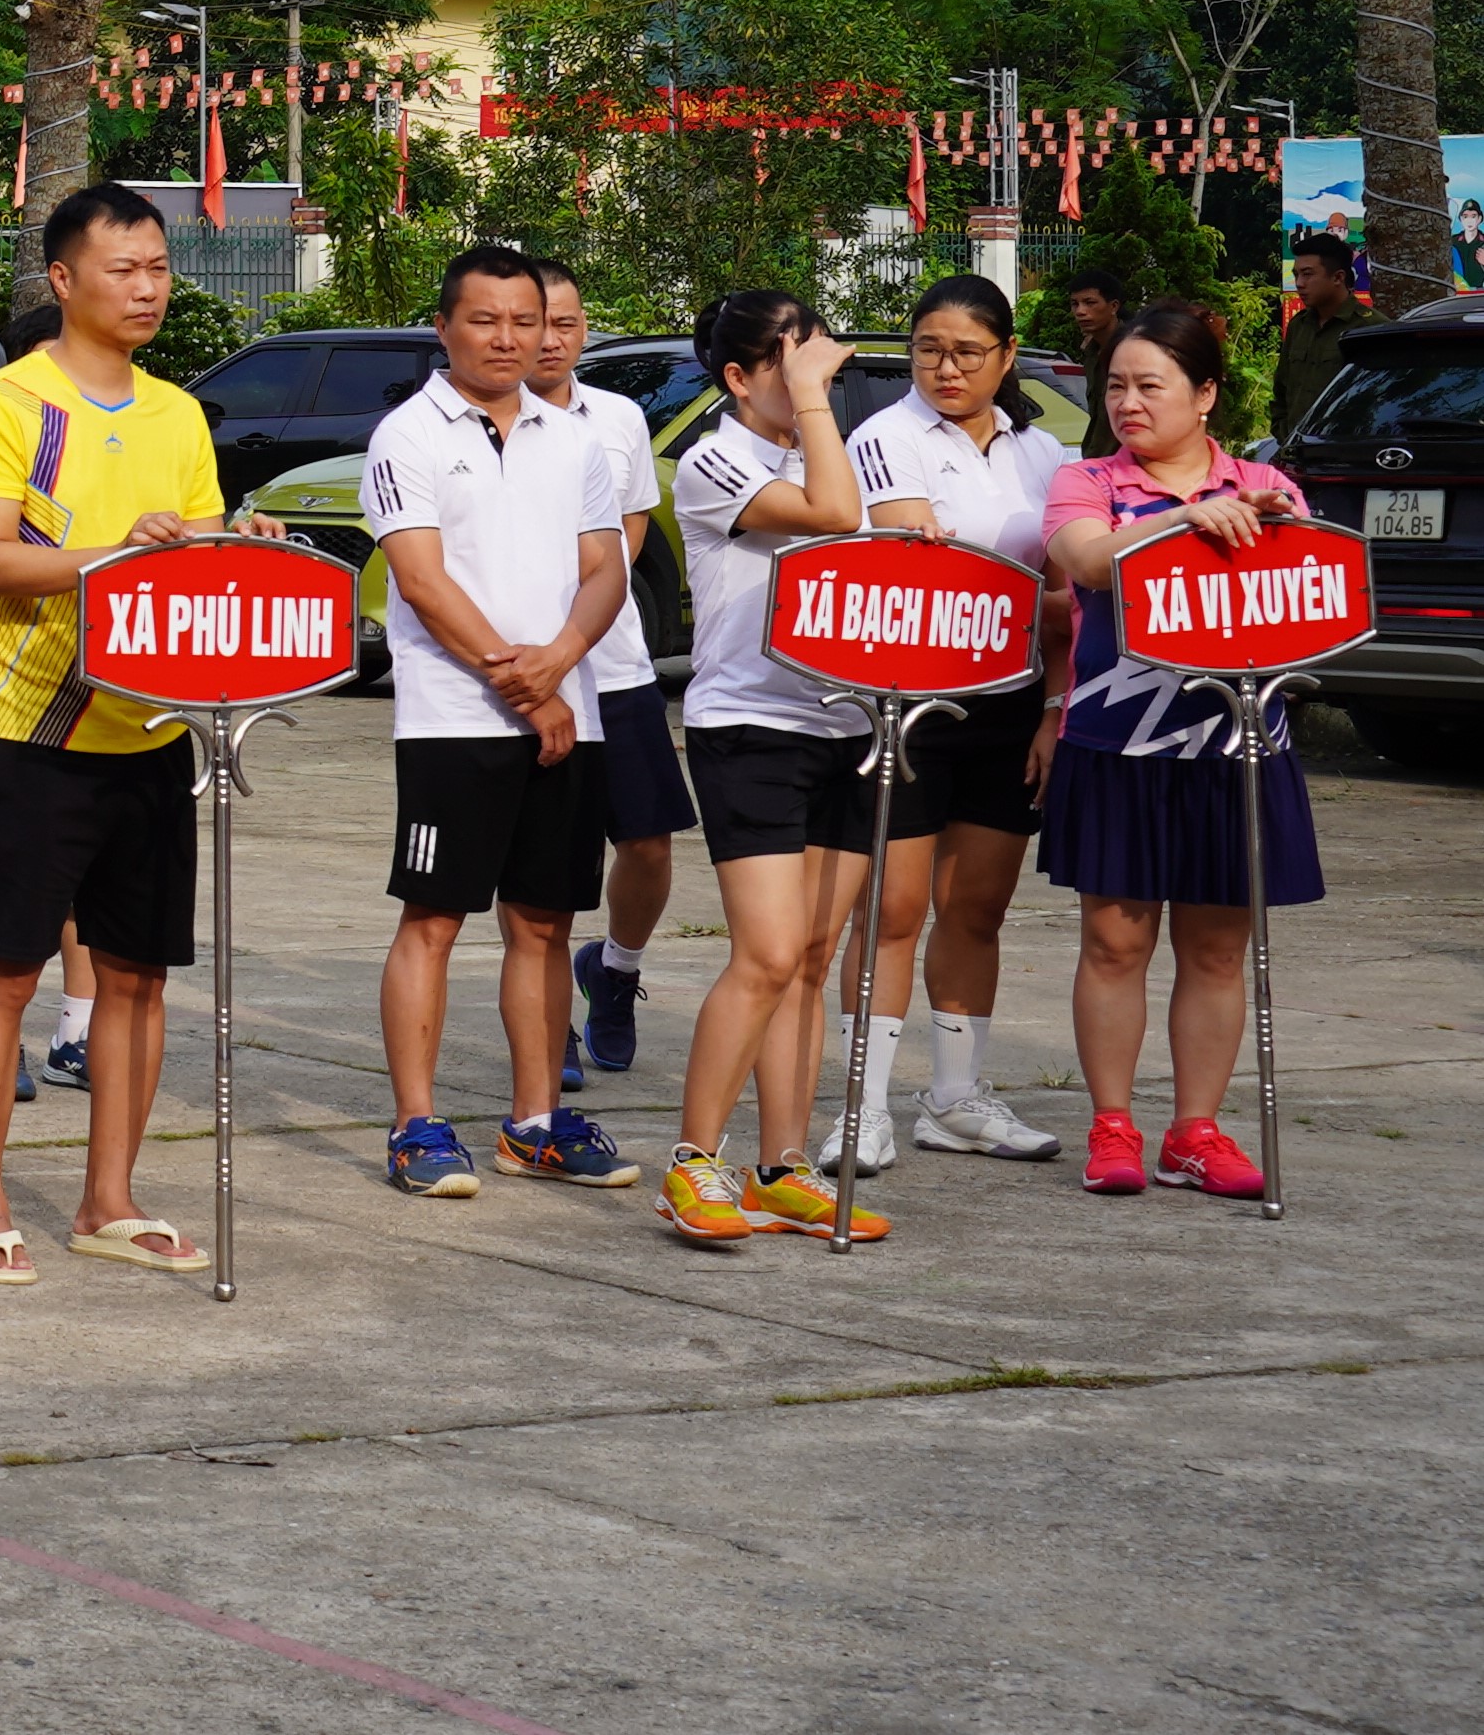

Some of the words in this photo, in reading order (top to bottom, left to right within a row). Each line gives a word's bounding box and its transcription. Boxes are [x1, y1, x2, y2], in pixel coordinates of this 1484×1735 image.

[1374, 516, 1434, 536] 104.85
[1387, 493, 1420, 513] 23A
[106, 581, 157, 655] XÃ
[167, 581, 242, 658] PHÚ
[251, 596, 334, 659] LINH
[792, 569, 838, 639] XÃ
[841, 582, 925, 654] BẠCH
[928, 589, 1013, 662] NGỌC
[1144, 566, 1193, 635] XÃ
[1197, 573, 1233, 639] VỊ
[1238, 554, 1348, 627] XUYÊN
